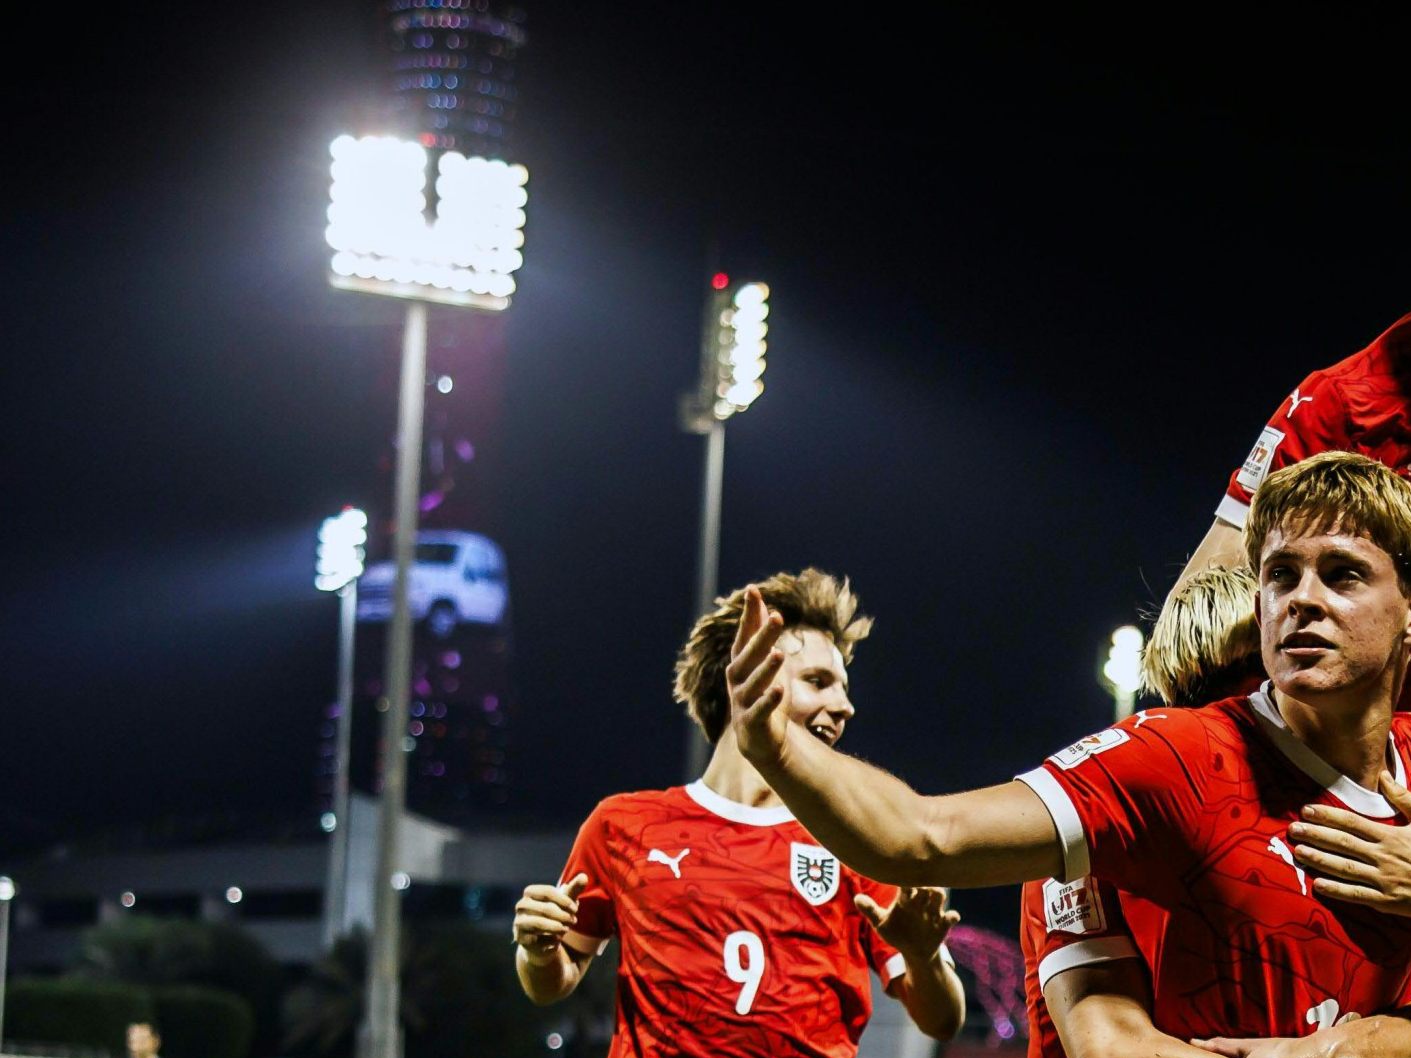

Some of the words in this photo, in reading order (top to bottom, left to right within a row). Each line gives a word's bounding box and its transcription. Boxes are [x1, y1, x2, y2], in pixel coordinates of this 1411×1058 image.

[1058, 885, 1074, 897] FIFA
[1055, 910, 1076, 926] WORLD
[723, 930, 765, 1015] 9
